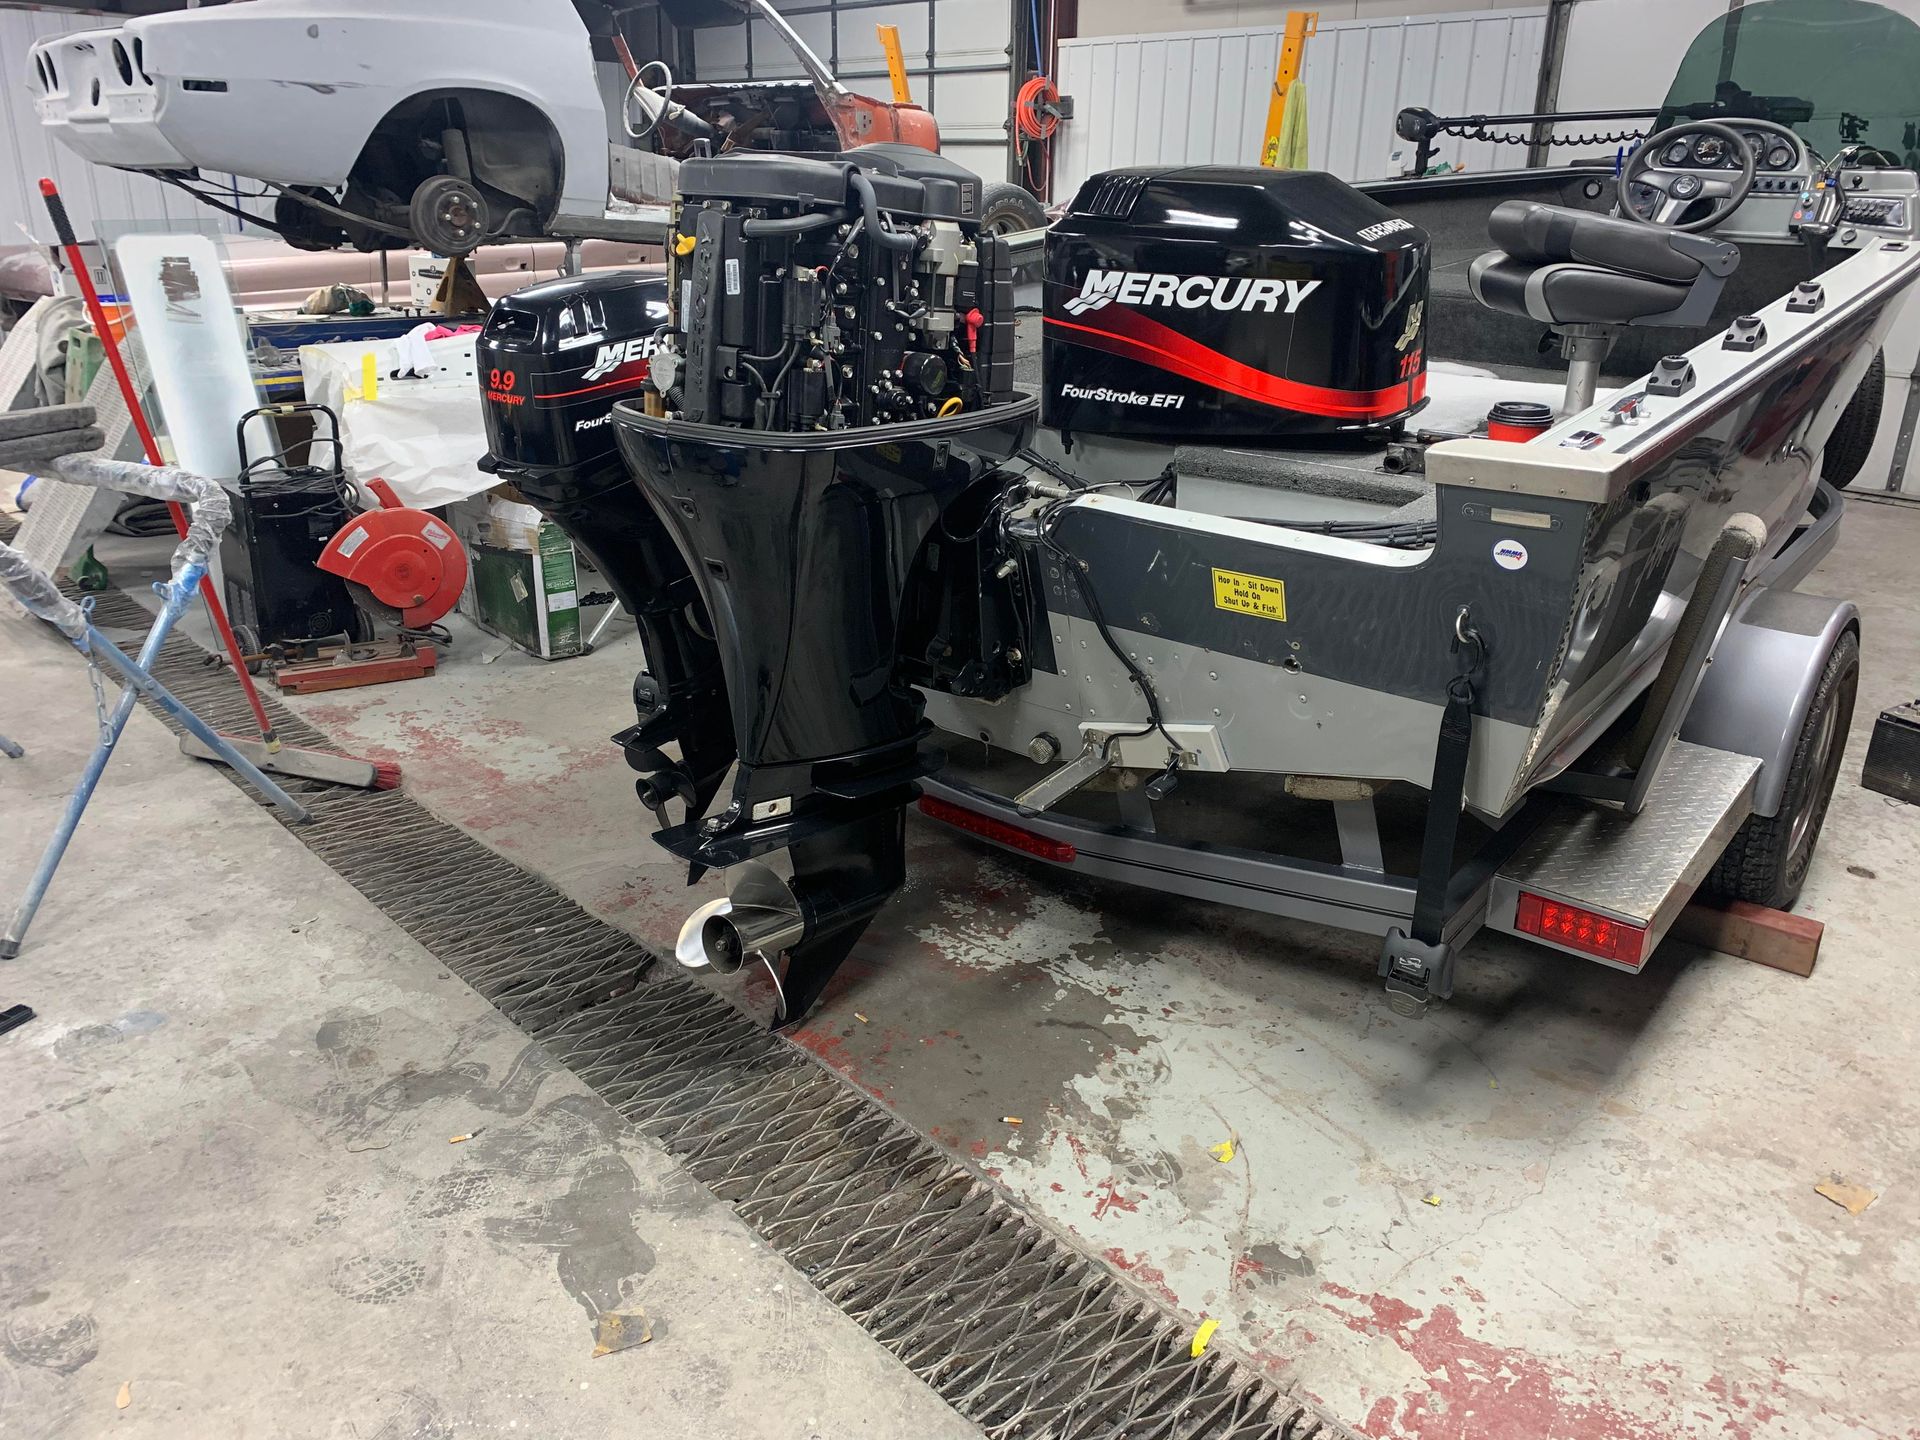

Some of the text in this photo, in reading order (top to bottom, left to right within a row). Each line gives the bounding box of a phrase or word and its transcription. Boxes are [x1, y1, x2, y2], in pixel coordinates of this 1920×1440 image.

[1063, 269, 1323, 316] MERCURY
[581, 335, 669, 382] MER
[1400, 349, 1422, 378] 115
[489, 368, 516, 391] 9.9
[487, 391, 525, 406] MERCURY
[1061, 383, 1185, 409] FourStroke EFI
[575, 412, 612, 432] FourS
[1217, 575, 1231, 584] Hop
[1233, 578, 1240, 587] In
[1247, 581, 1258, 590] Sit
[1260, 583, 1279, 594] Down
[1234, 587, 1261, 600] Hold On
[1223, 595, 1239, 606] Shut
[1241, 599, 1250, 608] Up
[1253, 602, 1259, 610] &
